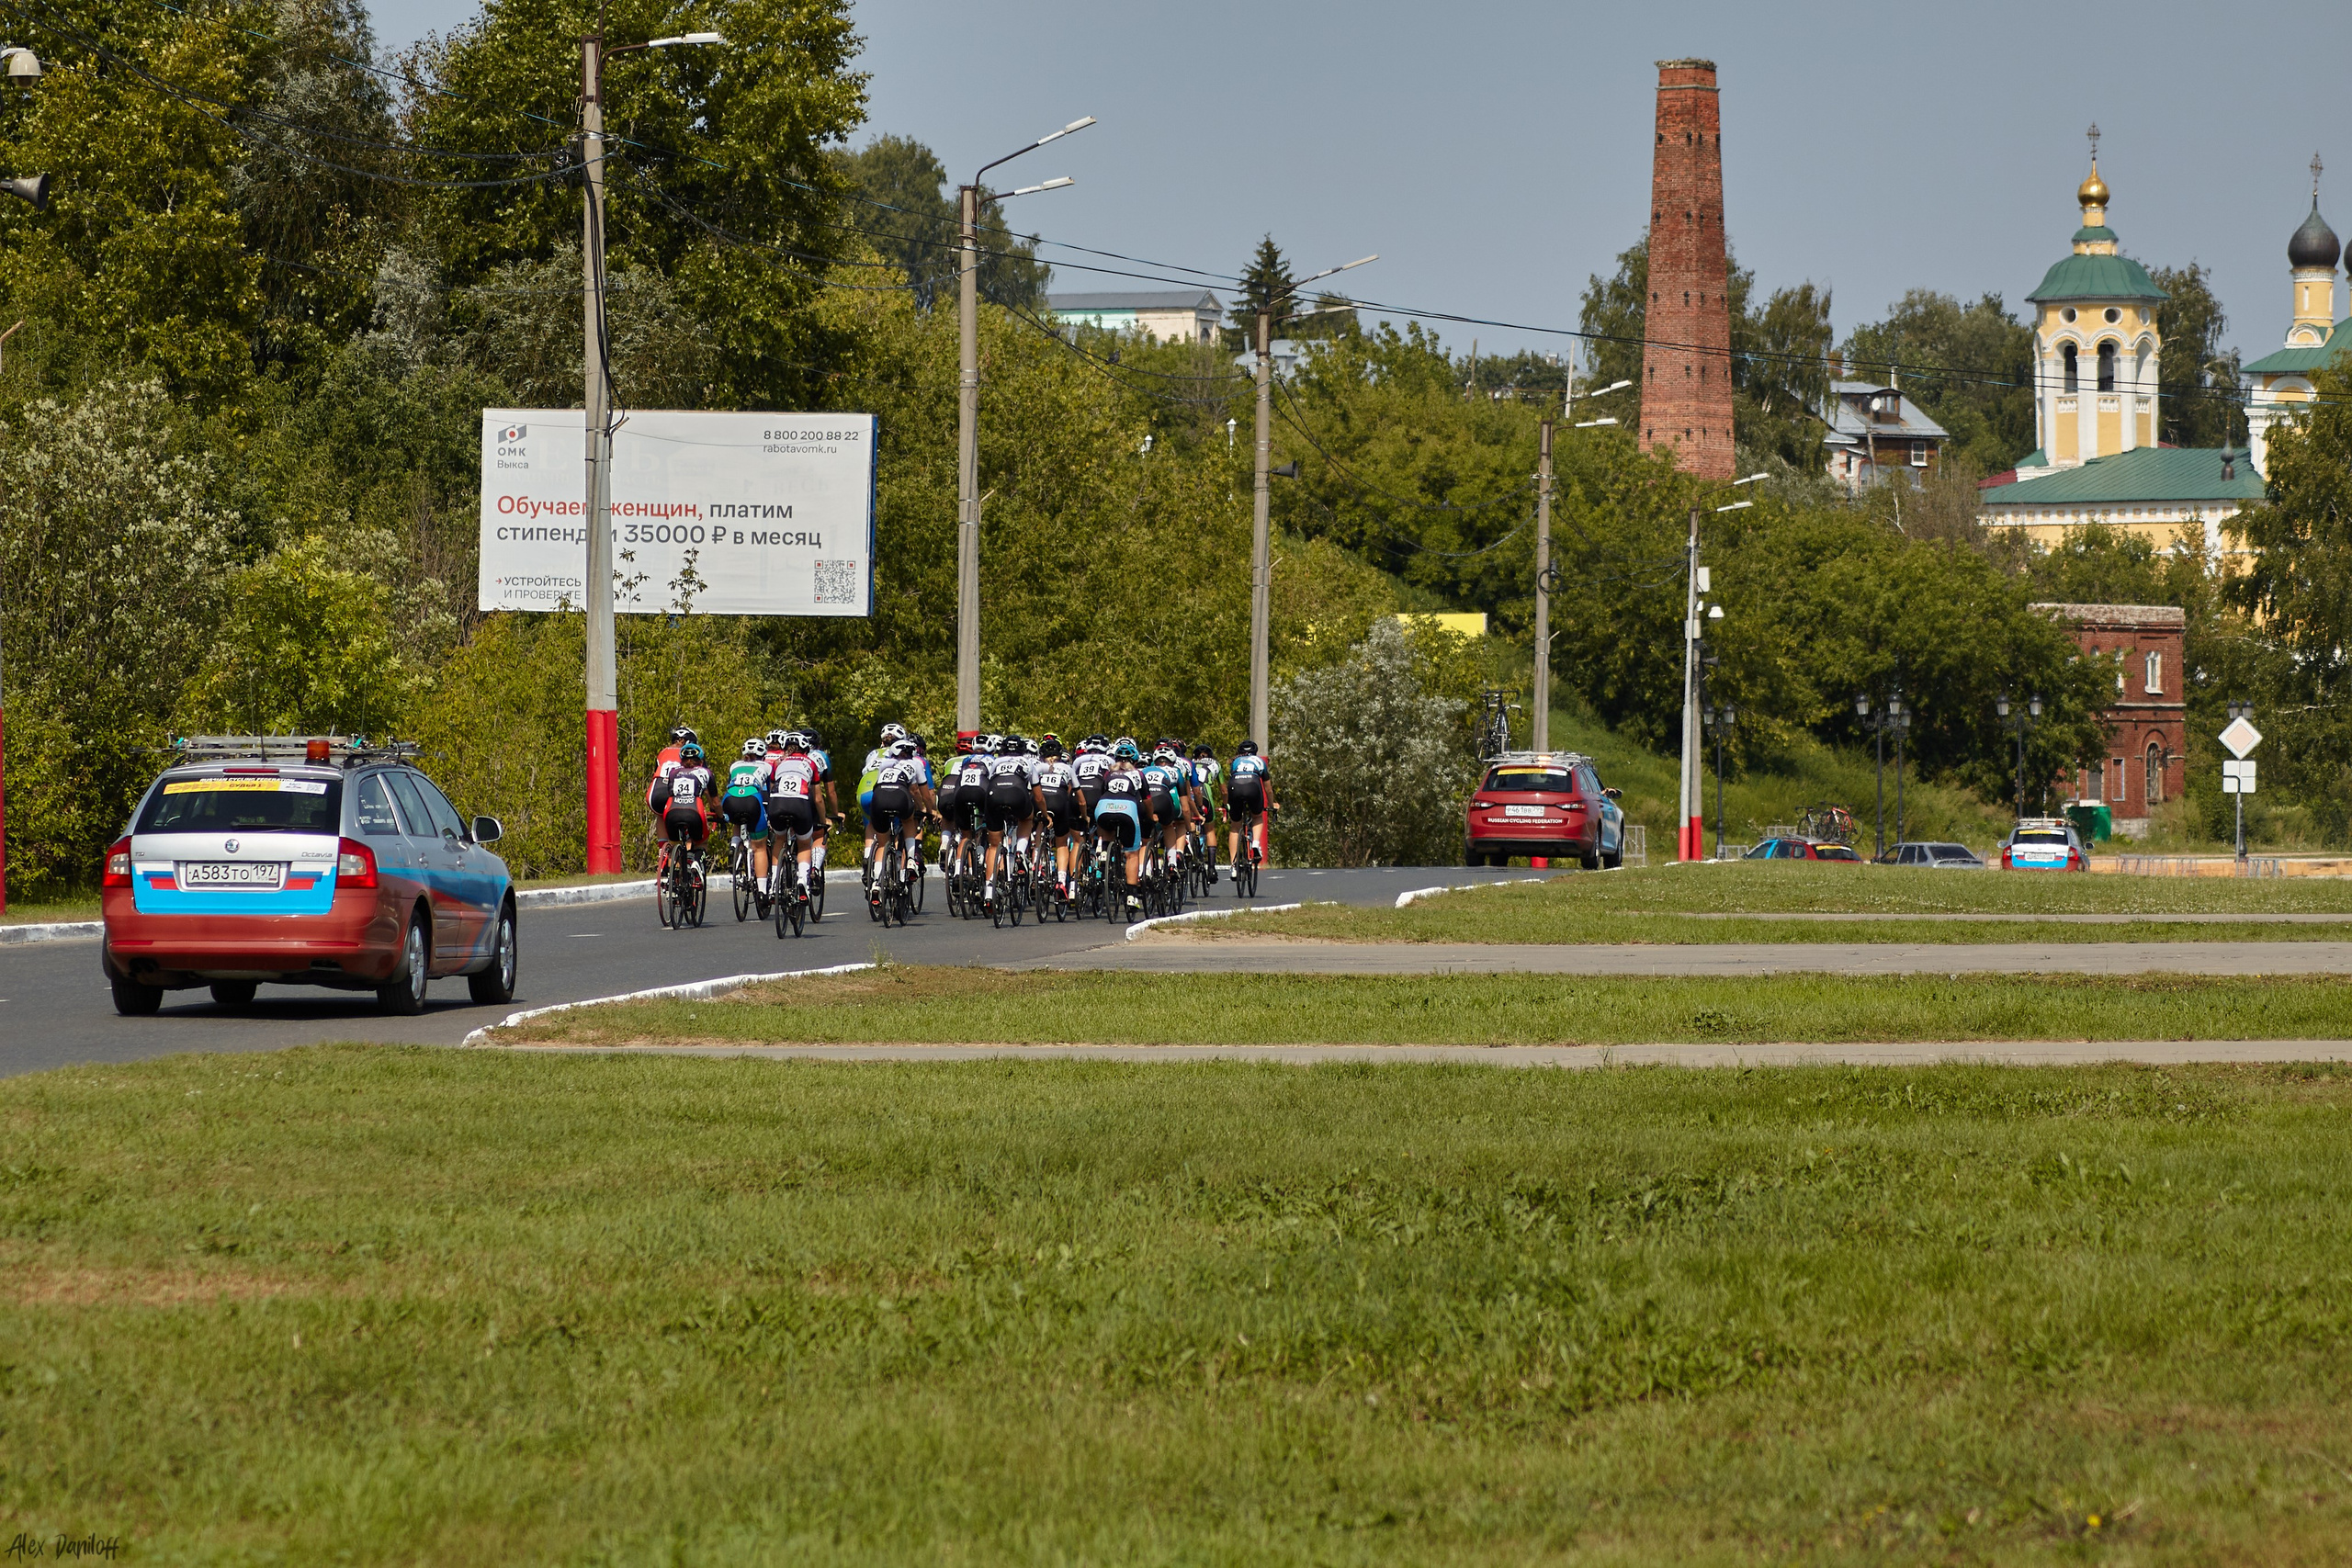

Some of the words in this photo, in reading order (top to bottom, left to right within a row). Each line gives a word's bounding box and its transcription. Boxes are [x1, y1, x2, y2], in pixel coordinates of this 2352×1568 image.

[763, 430, 771, 440] 8
[774, 430, 797, 440] 800
[800, 431, 823, 441] 200
[826, 431, 842, 441] 88
[844, 431, 859, 441] 22
[497, 447, 526, 457] ОМК
[763, 444, 837, 454] rabotavomk.ru
[497, 460, 528, 469] Выкса
[497, 495, 586, 519] Обучае
[710, 504, 793, 519] платим
[624, 524, 706, 544] 35000
[733, 531, 744, 545] в
[752, 531, 821, 549] месяц
[504, 575, 582, 587] УСТРОЙТЕСЬ
[504, 590, 512, 599] И
[740, 776, 750, 785] 13
[965, 774, 976, 784] 28
[677, 784, 689, 794] 34
[783, 781, 797, 792] 32
[1112, 782, 1125, 791] 36
[253, 864, 274, 876] 197
